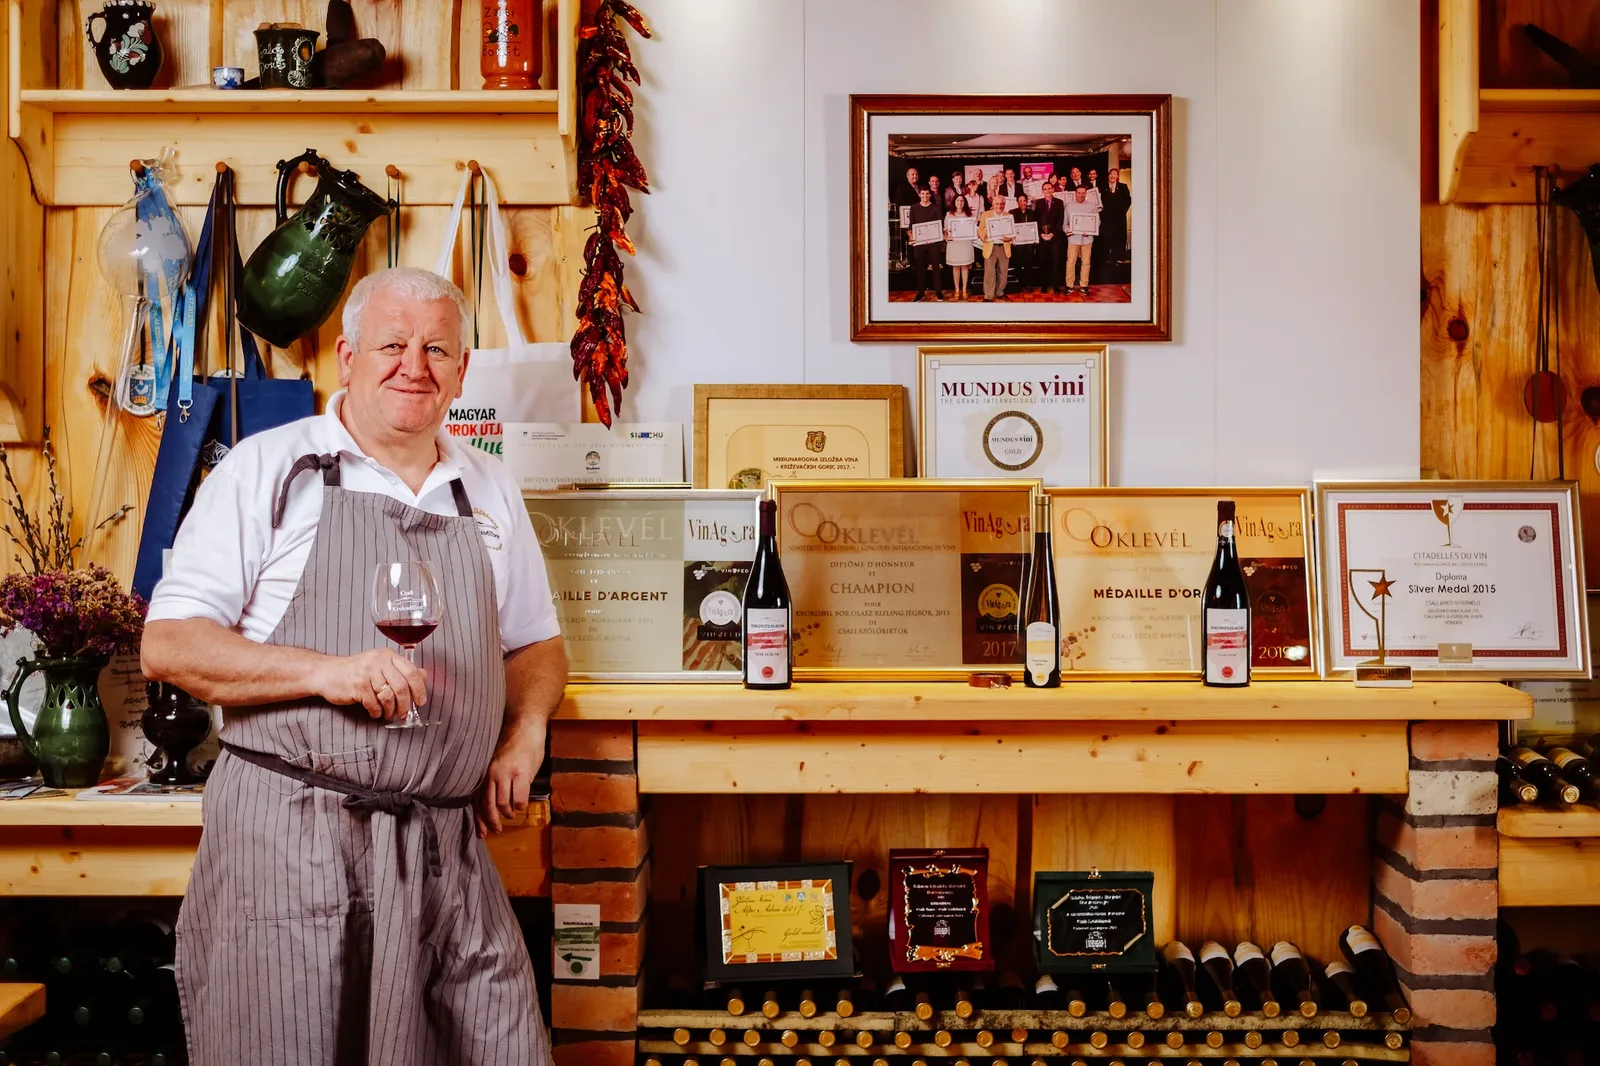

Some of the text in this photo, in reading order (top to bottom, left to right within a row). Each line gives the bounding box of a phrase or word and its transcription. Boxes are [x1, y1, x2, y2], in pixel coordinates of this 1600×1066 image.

[941, 374, 1084, 396] MUNDUS vini
[449, 408, 496, 420] MAGYAR
[445, 424, 478, 436] OROK
[964, 511, 1030, 538] VinAgora
[1236, 516, 1302, 543] VinAgora
[688, 519, 755, 546] VinAgora
[816, 520, 920, 543] OKLEVÉL
[1090, 526, 1191, 548] OKLEVÉL
[1436, 572, 1467, 582] Diploma
[830, 583, 915, 594] CHAMPION
[1094, 587, 1201, 598] MÉDAILLE D'OR
[1408, 584, 1496, 594] Silver Medal 2015
[553, 591, 668, 601] AILLE D'ARGENT
[982, 641, 1016, 656] 2017
